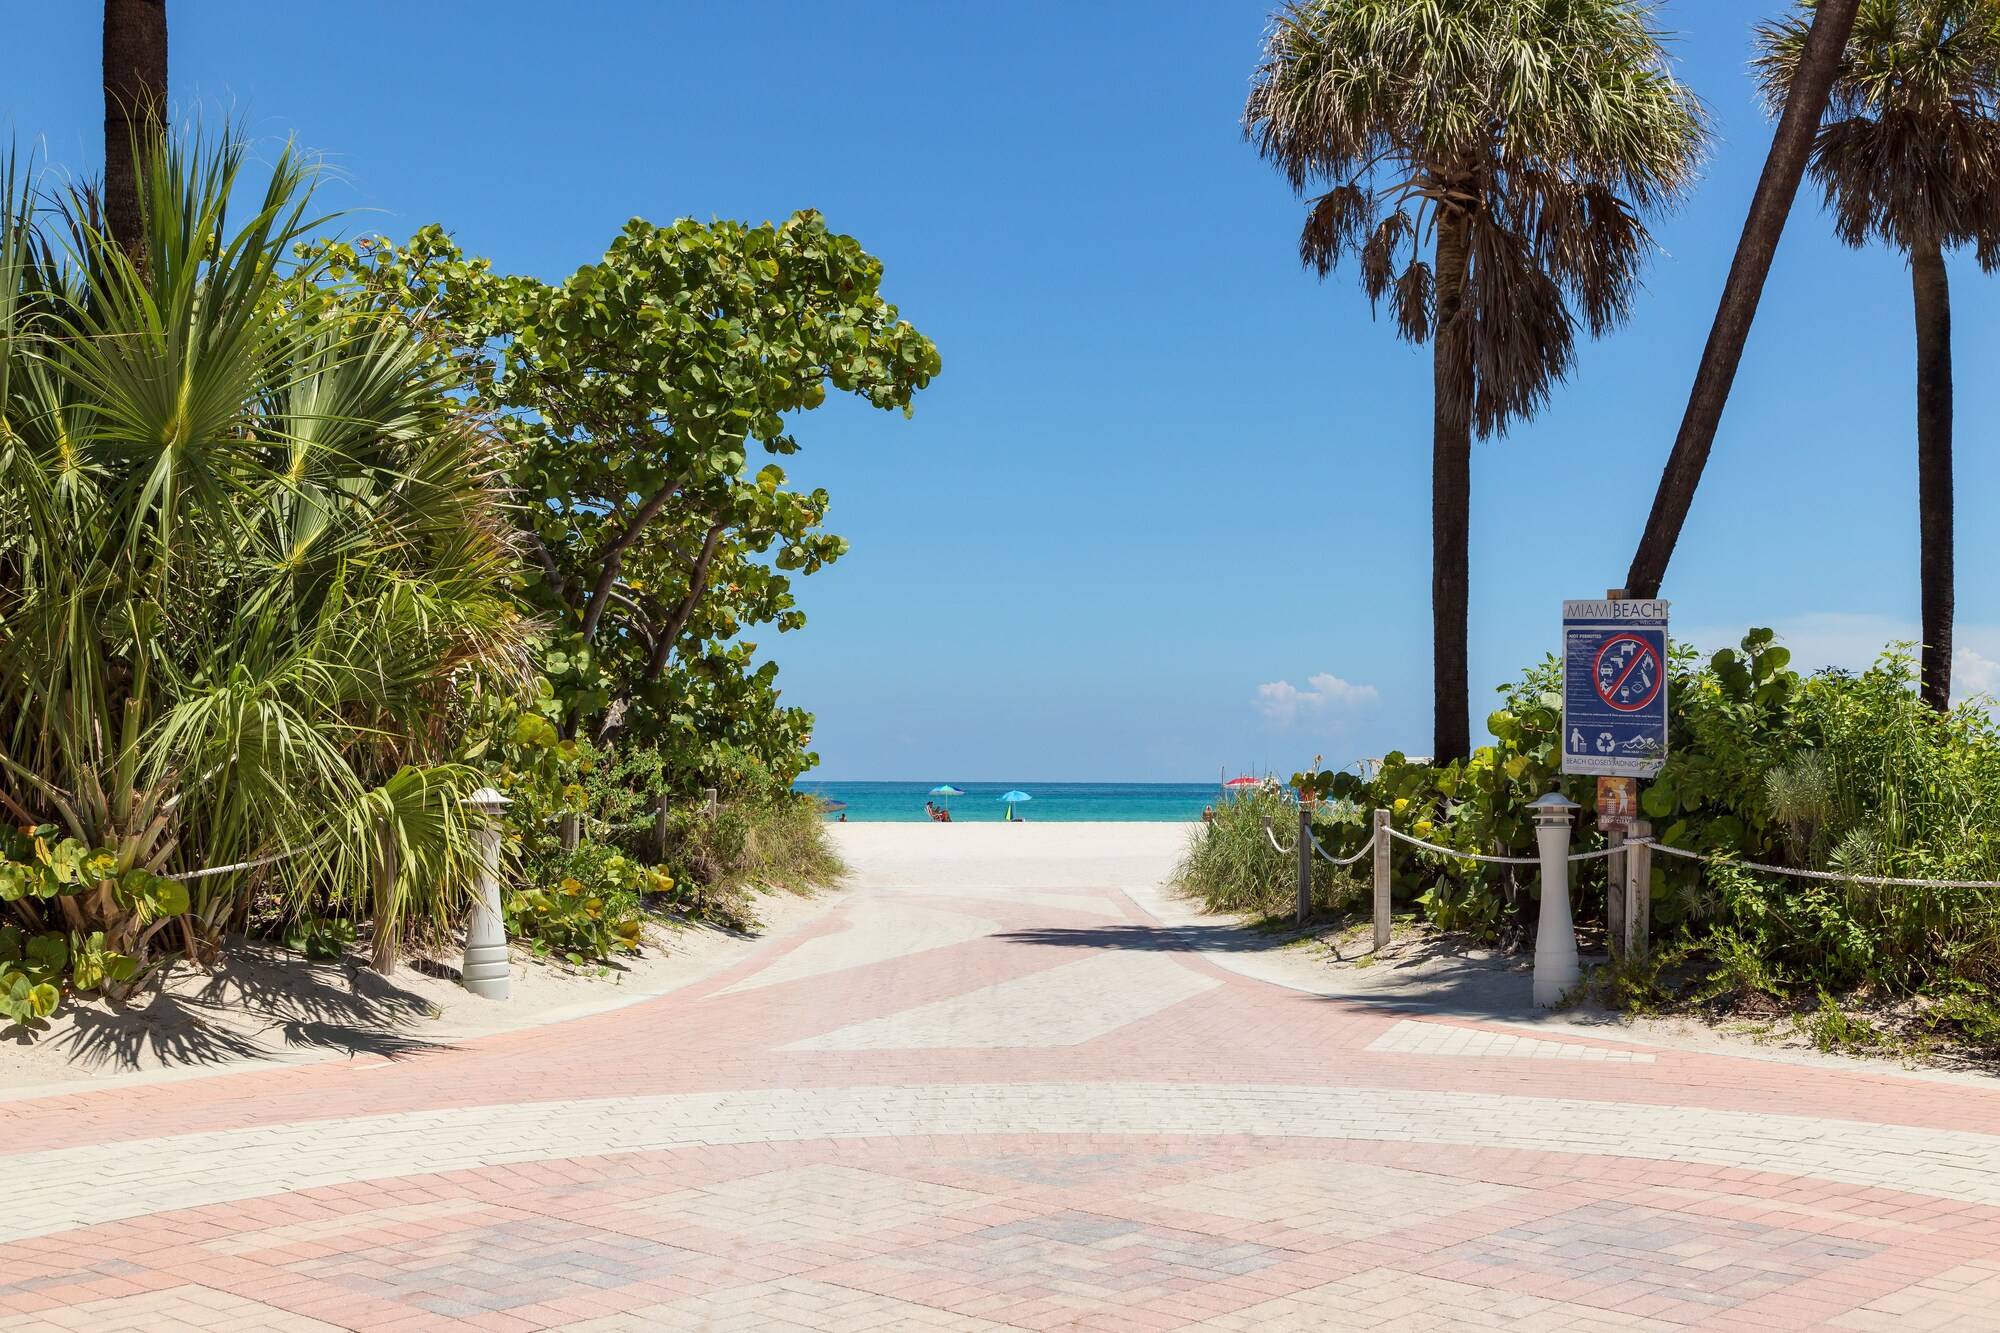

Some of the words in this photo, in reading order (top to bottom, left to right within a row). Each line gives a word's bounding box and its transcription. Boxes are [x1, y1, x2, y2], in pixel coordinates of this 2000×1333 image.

[1565, 757, 1587, 765] BEACH
[1587, 759, 1612, 767] CLOSED
[1612, 760, 1643, 768] MIDNIGH
